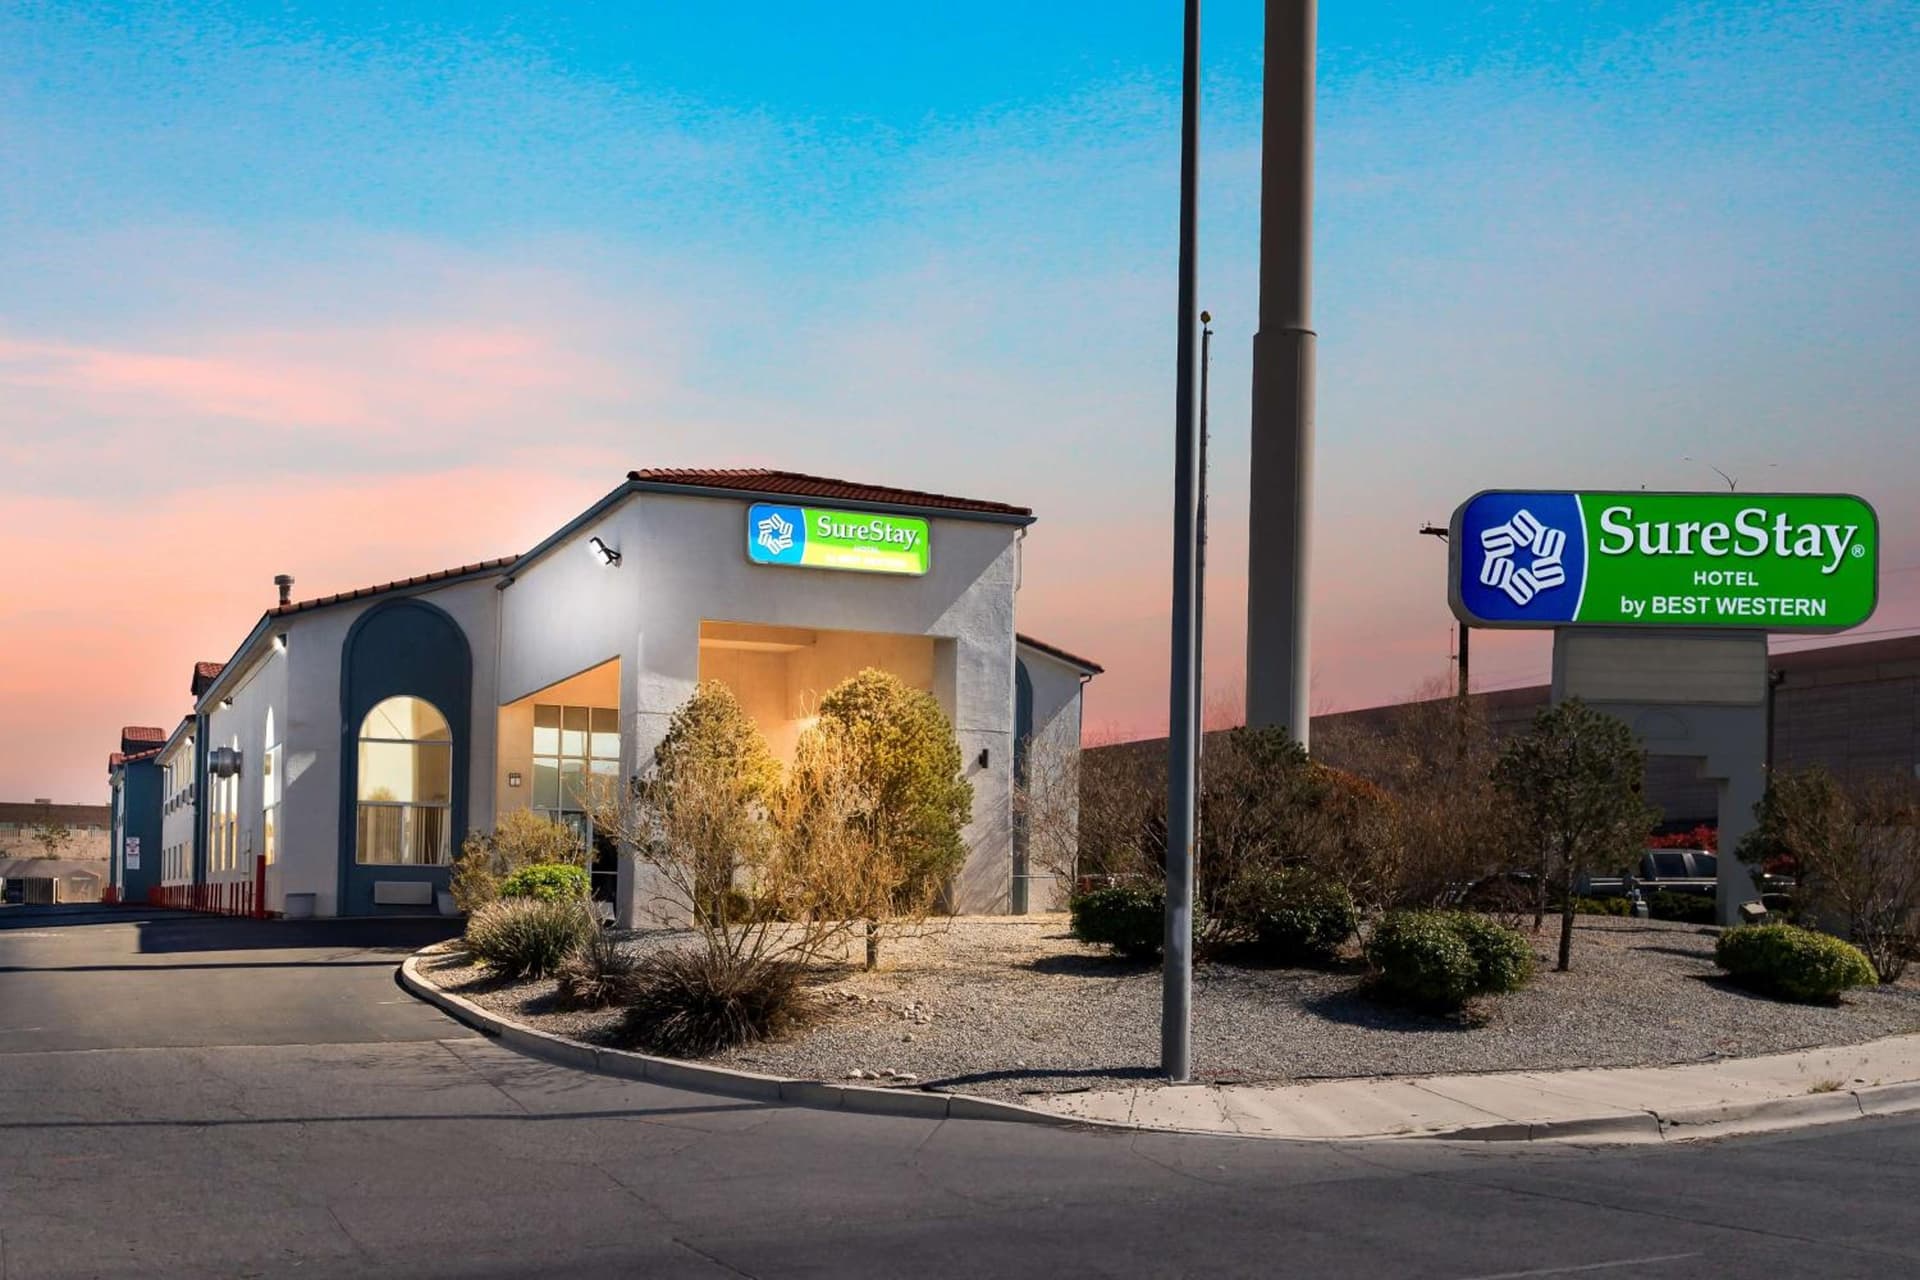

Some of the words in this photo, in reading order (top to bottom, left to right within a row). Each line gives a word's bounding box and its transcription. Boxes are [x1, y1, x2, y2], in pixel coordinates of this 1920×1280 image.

[1694, 571, 1759, 587] HOTEL
[1620, 596, 1646, 617] by
[1652, 597, 1710, 615] BEST
[1716, 597, 1827, 617] WESTERN
